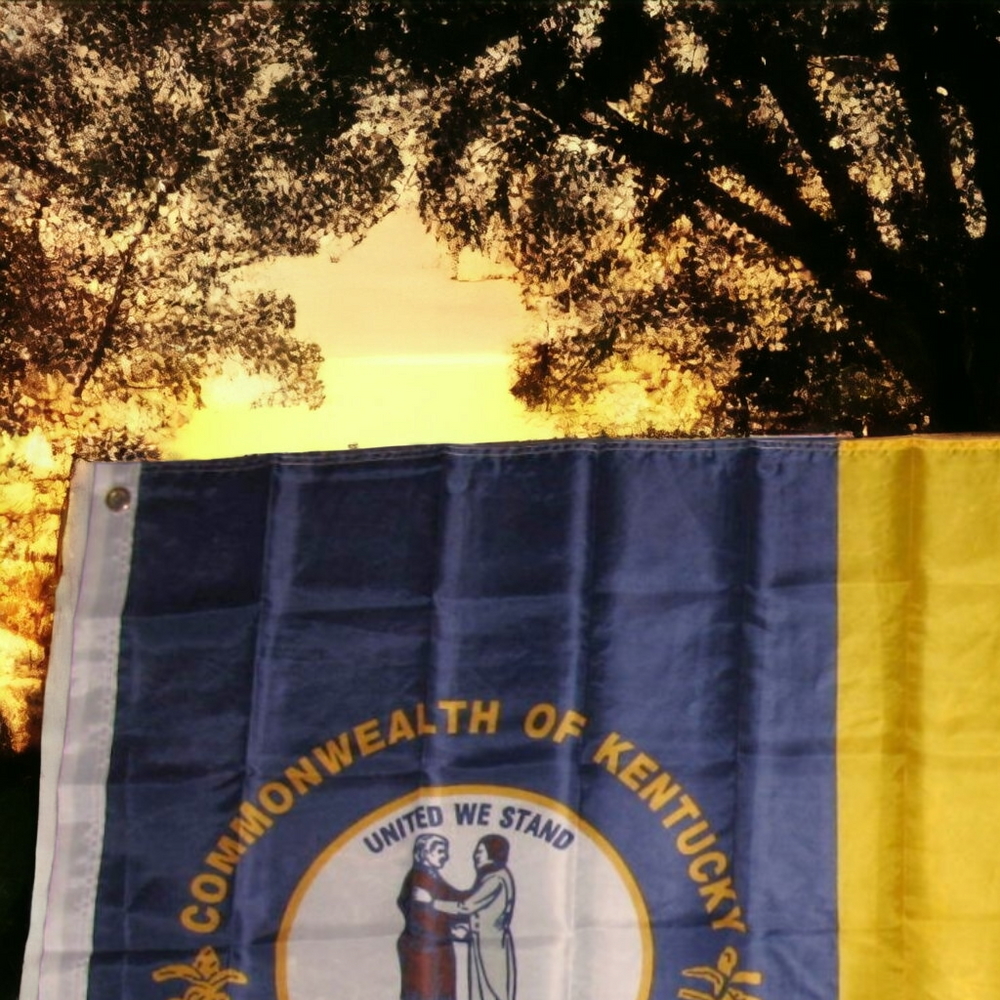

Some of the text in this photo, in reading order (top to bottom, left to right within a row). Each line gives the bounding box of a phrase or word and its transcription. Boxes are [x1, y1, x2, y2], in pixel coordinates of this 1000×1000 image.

[180, 701, 749, 935] COMMONWEALTH OF KENTUCKY
[363, 803, 575, 854] UNITED WE STAND
